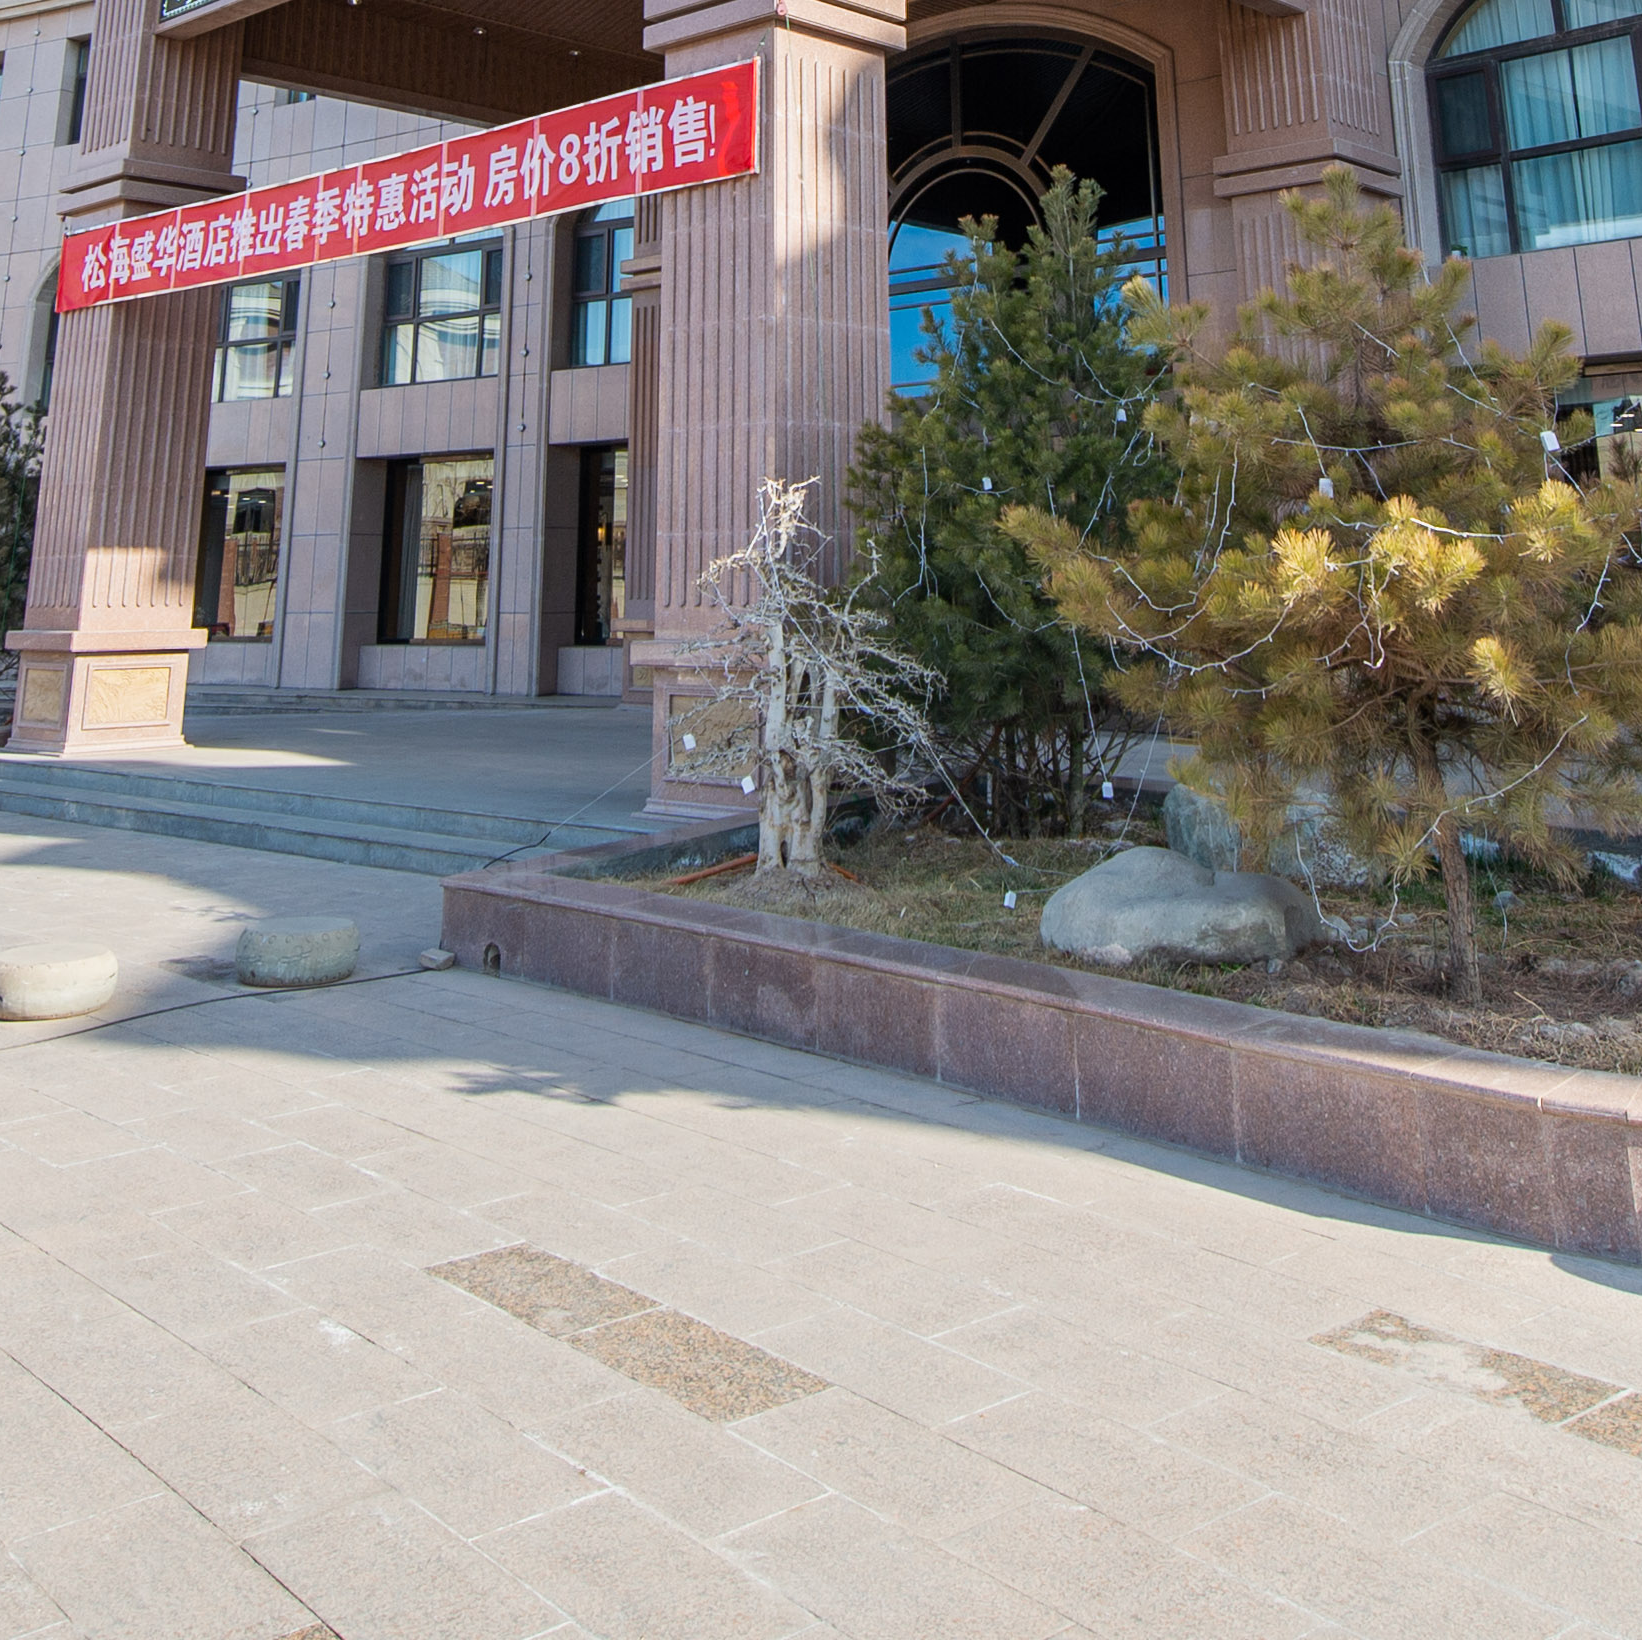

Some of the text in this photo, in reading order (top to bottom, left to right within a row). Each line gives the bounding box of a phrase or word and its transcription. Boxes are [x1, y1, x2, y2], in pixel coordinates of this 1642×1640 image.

[81, 156, 476, 291] 松海盛华酒店推出春季特惠活动
